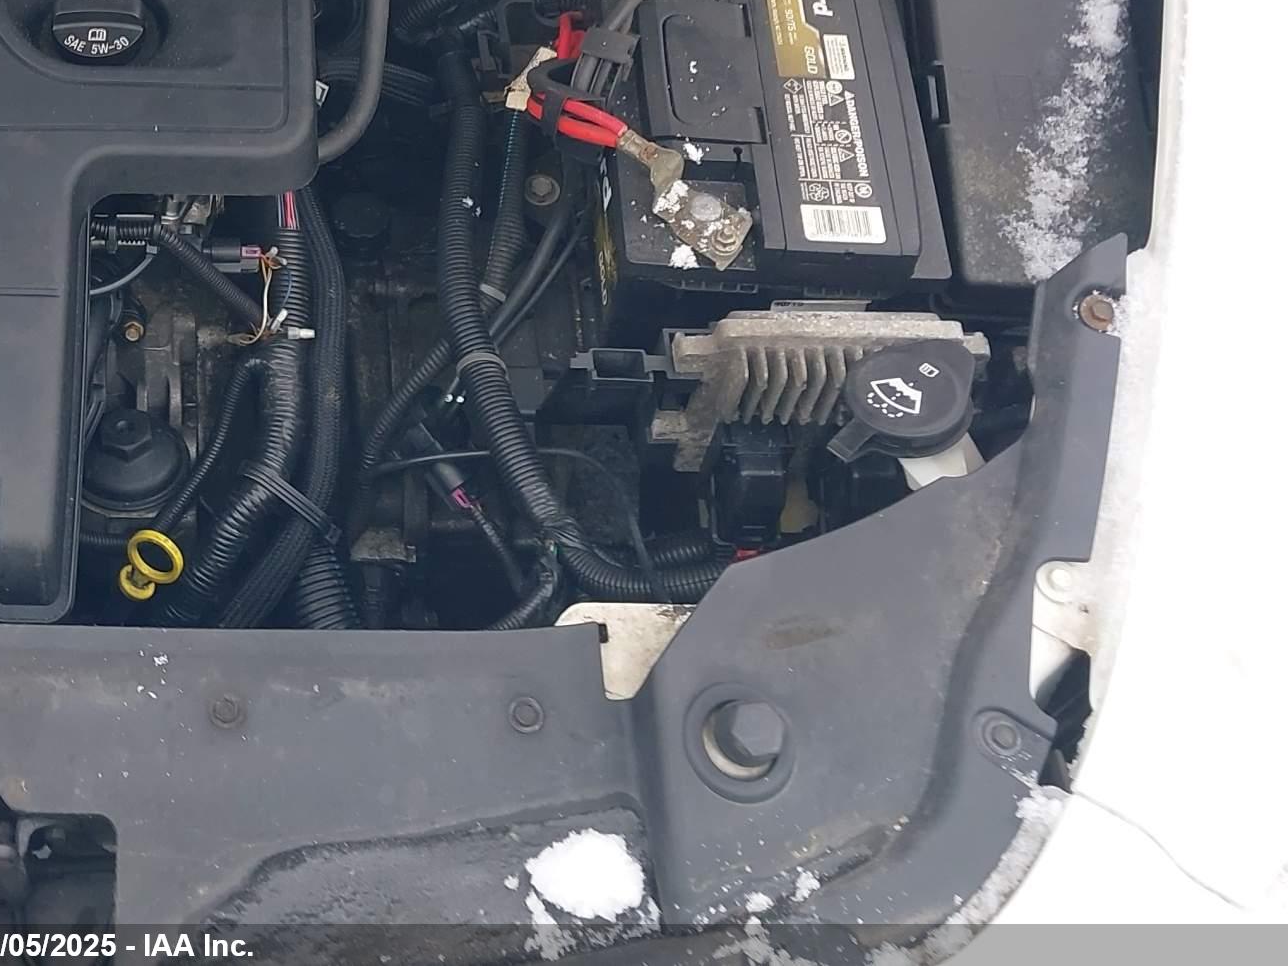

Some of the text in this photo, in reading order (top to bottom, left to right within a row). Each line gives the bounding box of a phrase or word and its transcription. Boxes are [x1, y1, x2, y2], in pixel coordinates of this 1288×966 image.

[64, 35, 130, 54] SAE 5W-30
[804, 45, 819, 75] GOLD
[844, 99, 870, 178] DANGER/POISON
